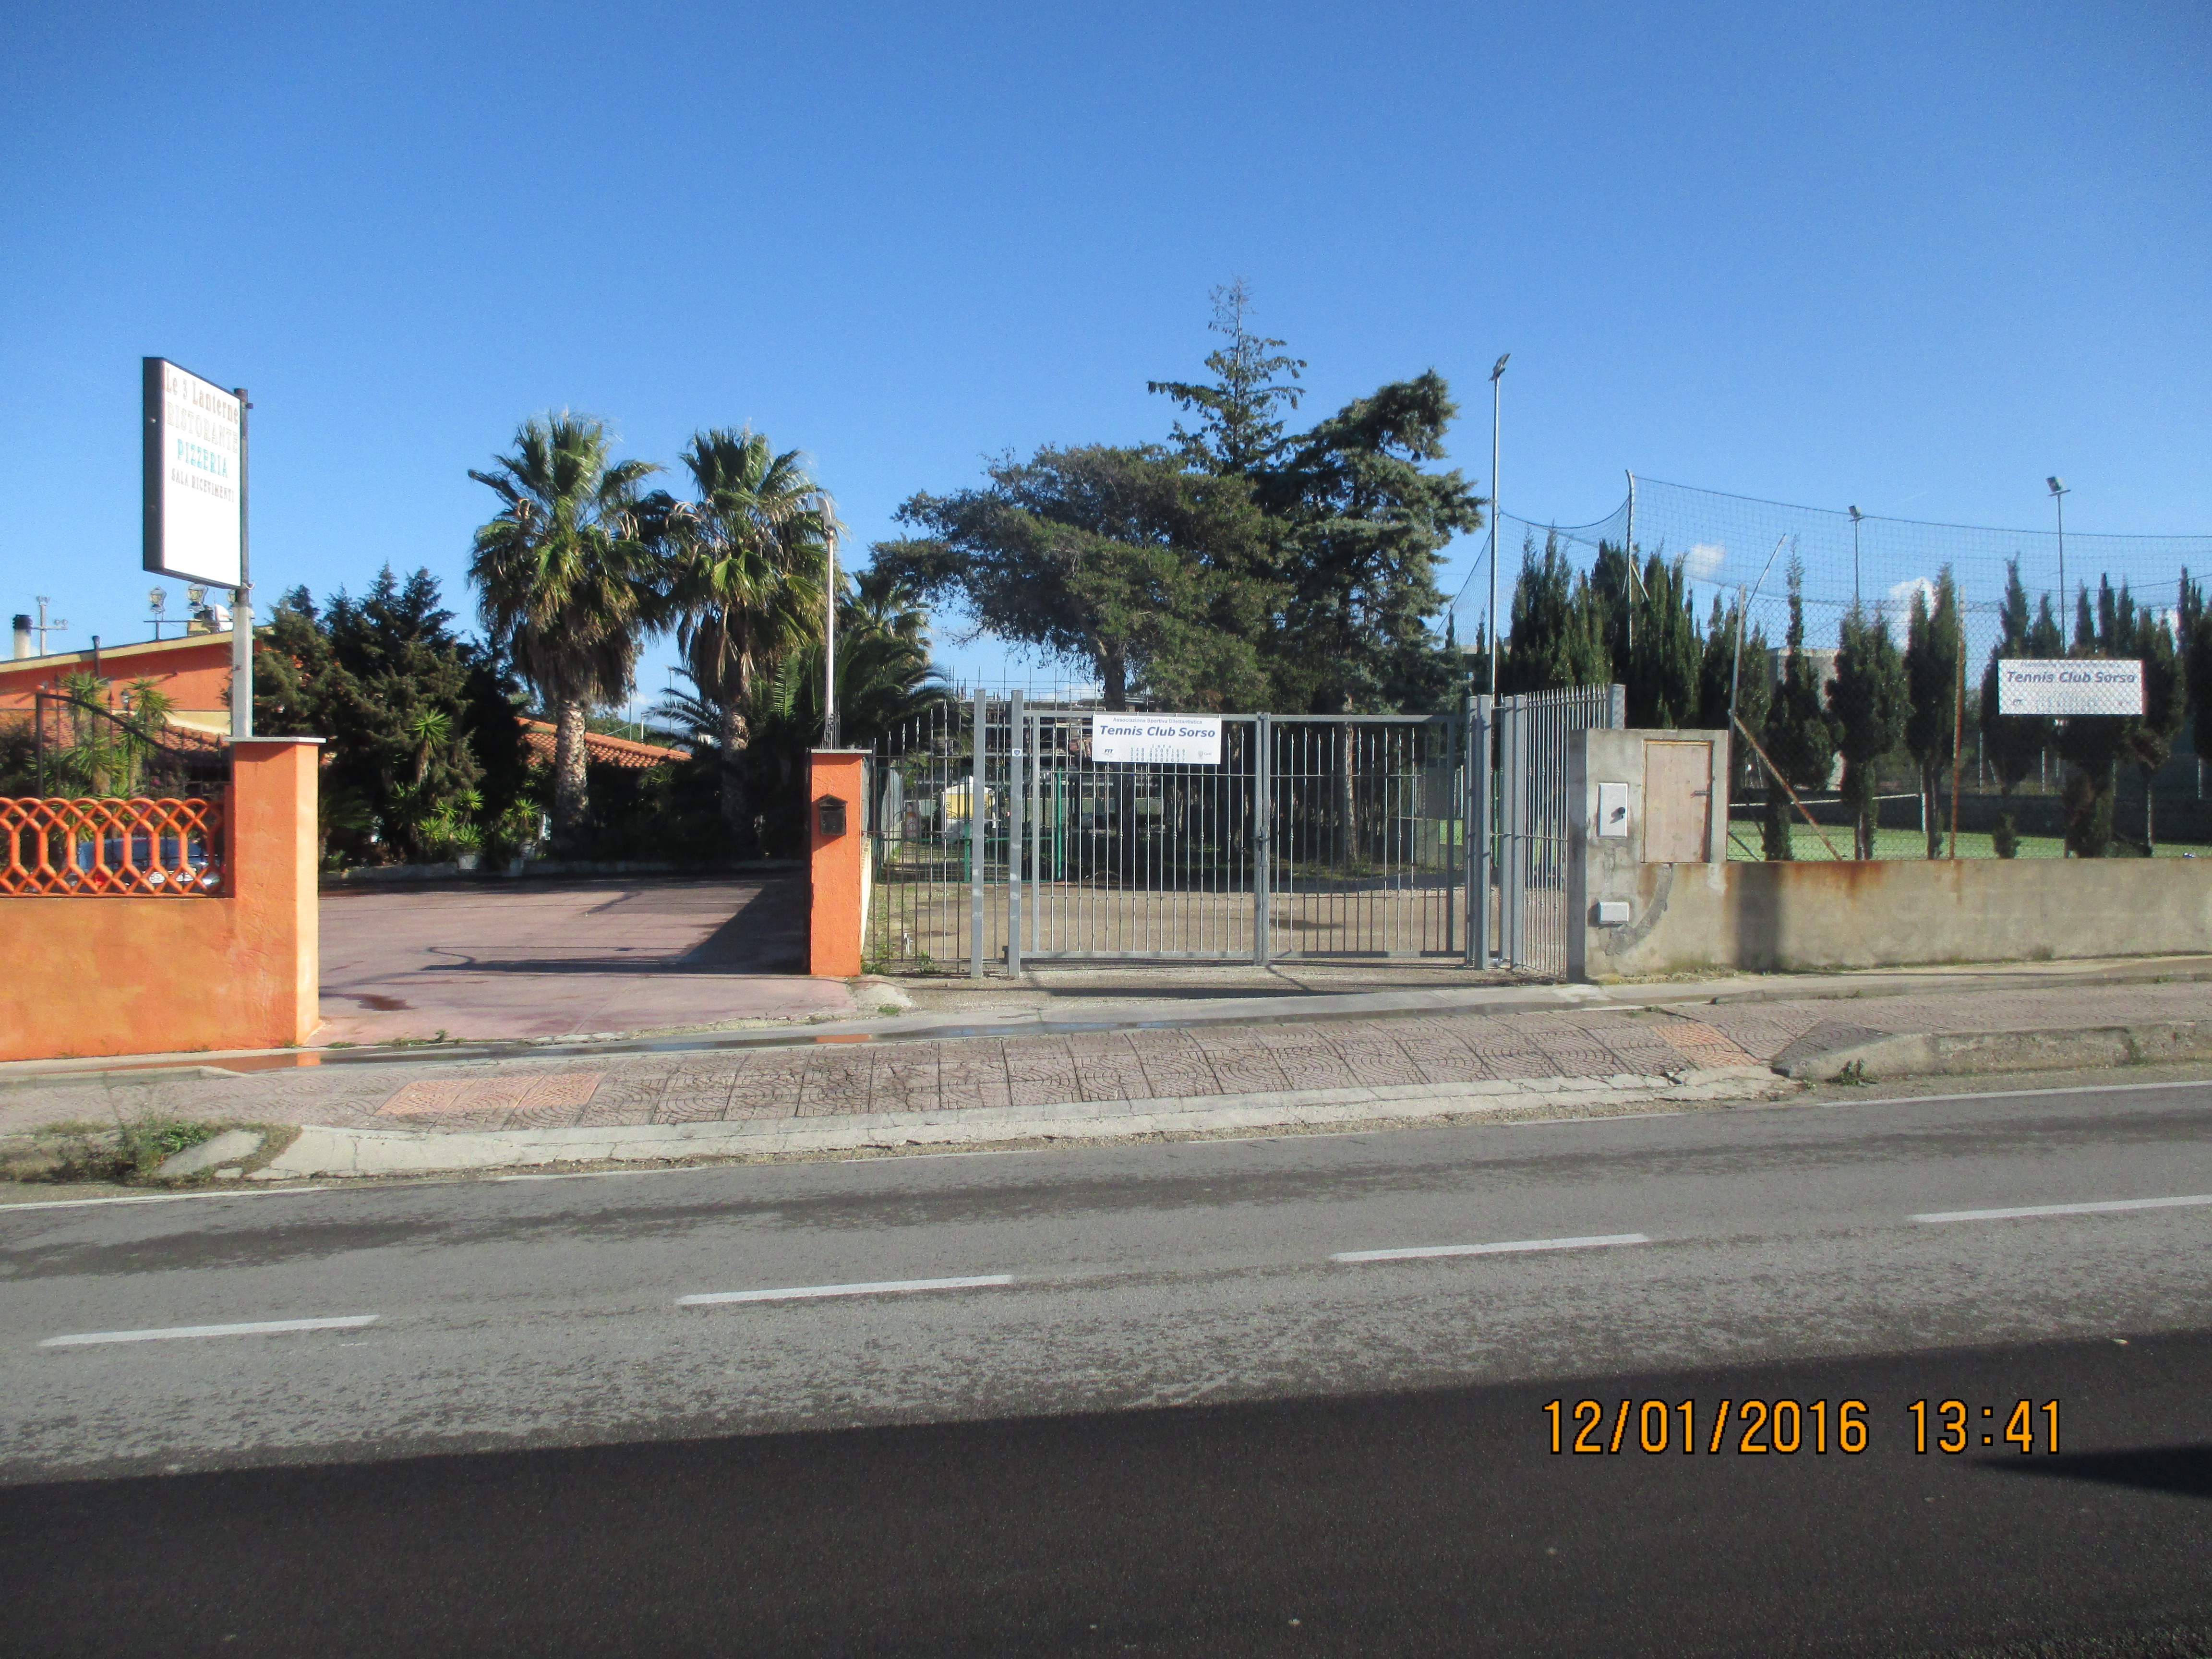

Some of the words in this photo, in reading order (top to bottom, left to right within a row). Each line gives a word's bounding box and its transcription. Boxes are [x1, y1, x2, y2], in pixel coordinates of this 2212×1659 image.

[165, 367, 178, 396] Le
[192, 380, 239, 425] Lanterne
[167, 401, 238, 454] RISTORANTE
[177, 438, 228, 479] PIZZERIA
[171, 468, 189, 487] SALA
[192, 475, 234, 503] RICEVIMENTI
[2007, 672, 2054, 683] Tennis
[2059, 672, 2091, 683] Club
[2094, 672, 2136, 683] Sorso
[1100, 725, 1143, 735] Tennis
[1147, 726, 1176, 736] Club
[1178, 727, 1215, 737] Sorso
